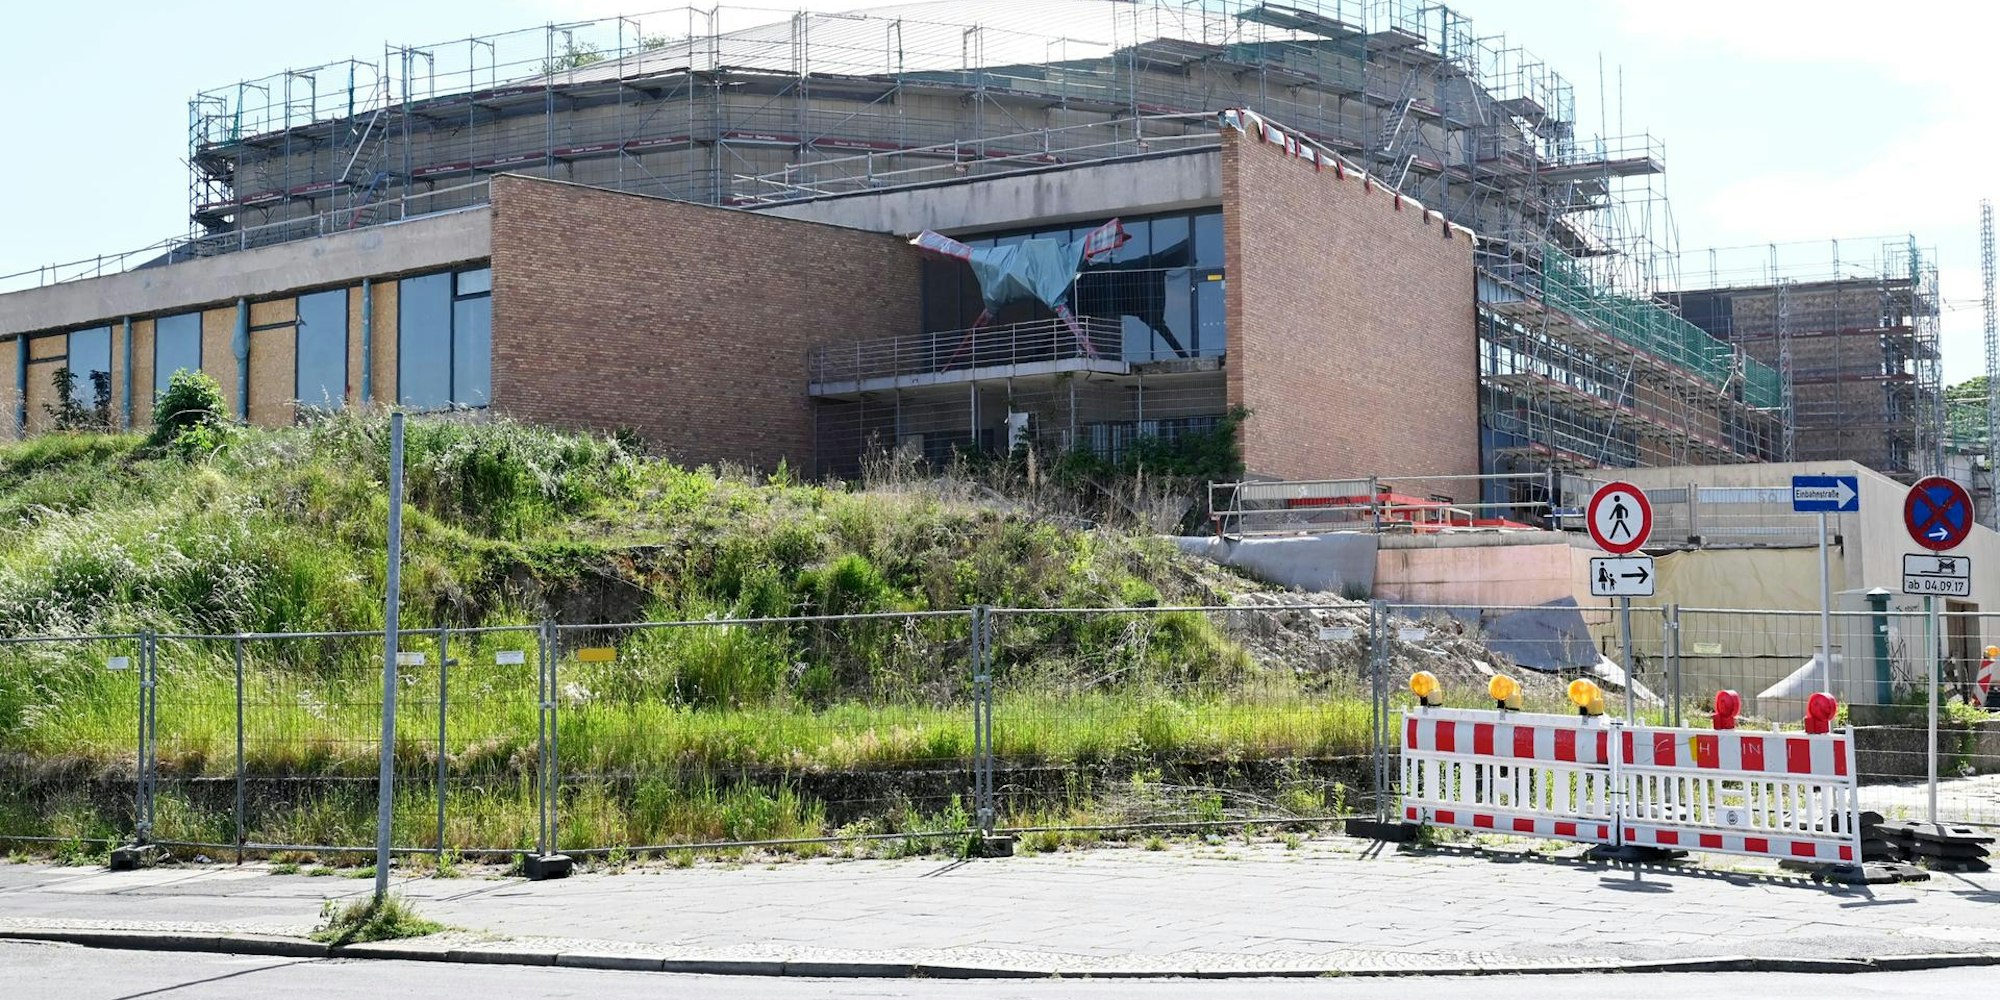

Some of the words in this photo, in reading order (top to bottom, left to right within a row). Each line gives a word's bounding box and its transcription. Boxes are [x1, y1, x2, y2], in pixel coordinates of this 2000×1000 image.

[1796, 489, 1839, 499] Einbahnstraße
[1908, 579, 1920, 590] ab
[1924, 579, 1964, 592] 04.09.17
